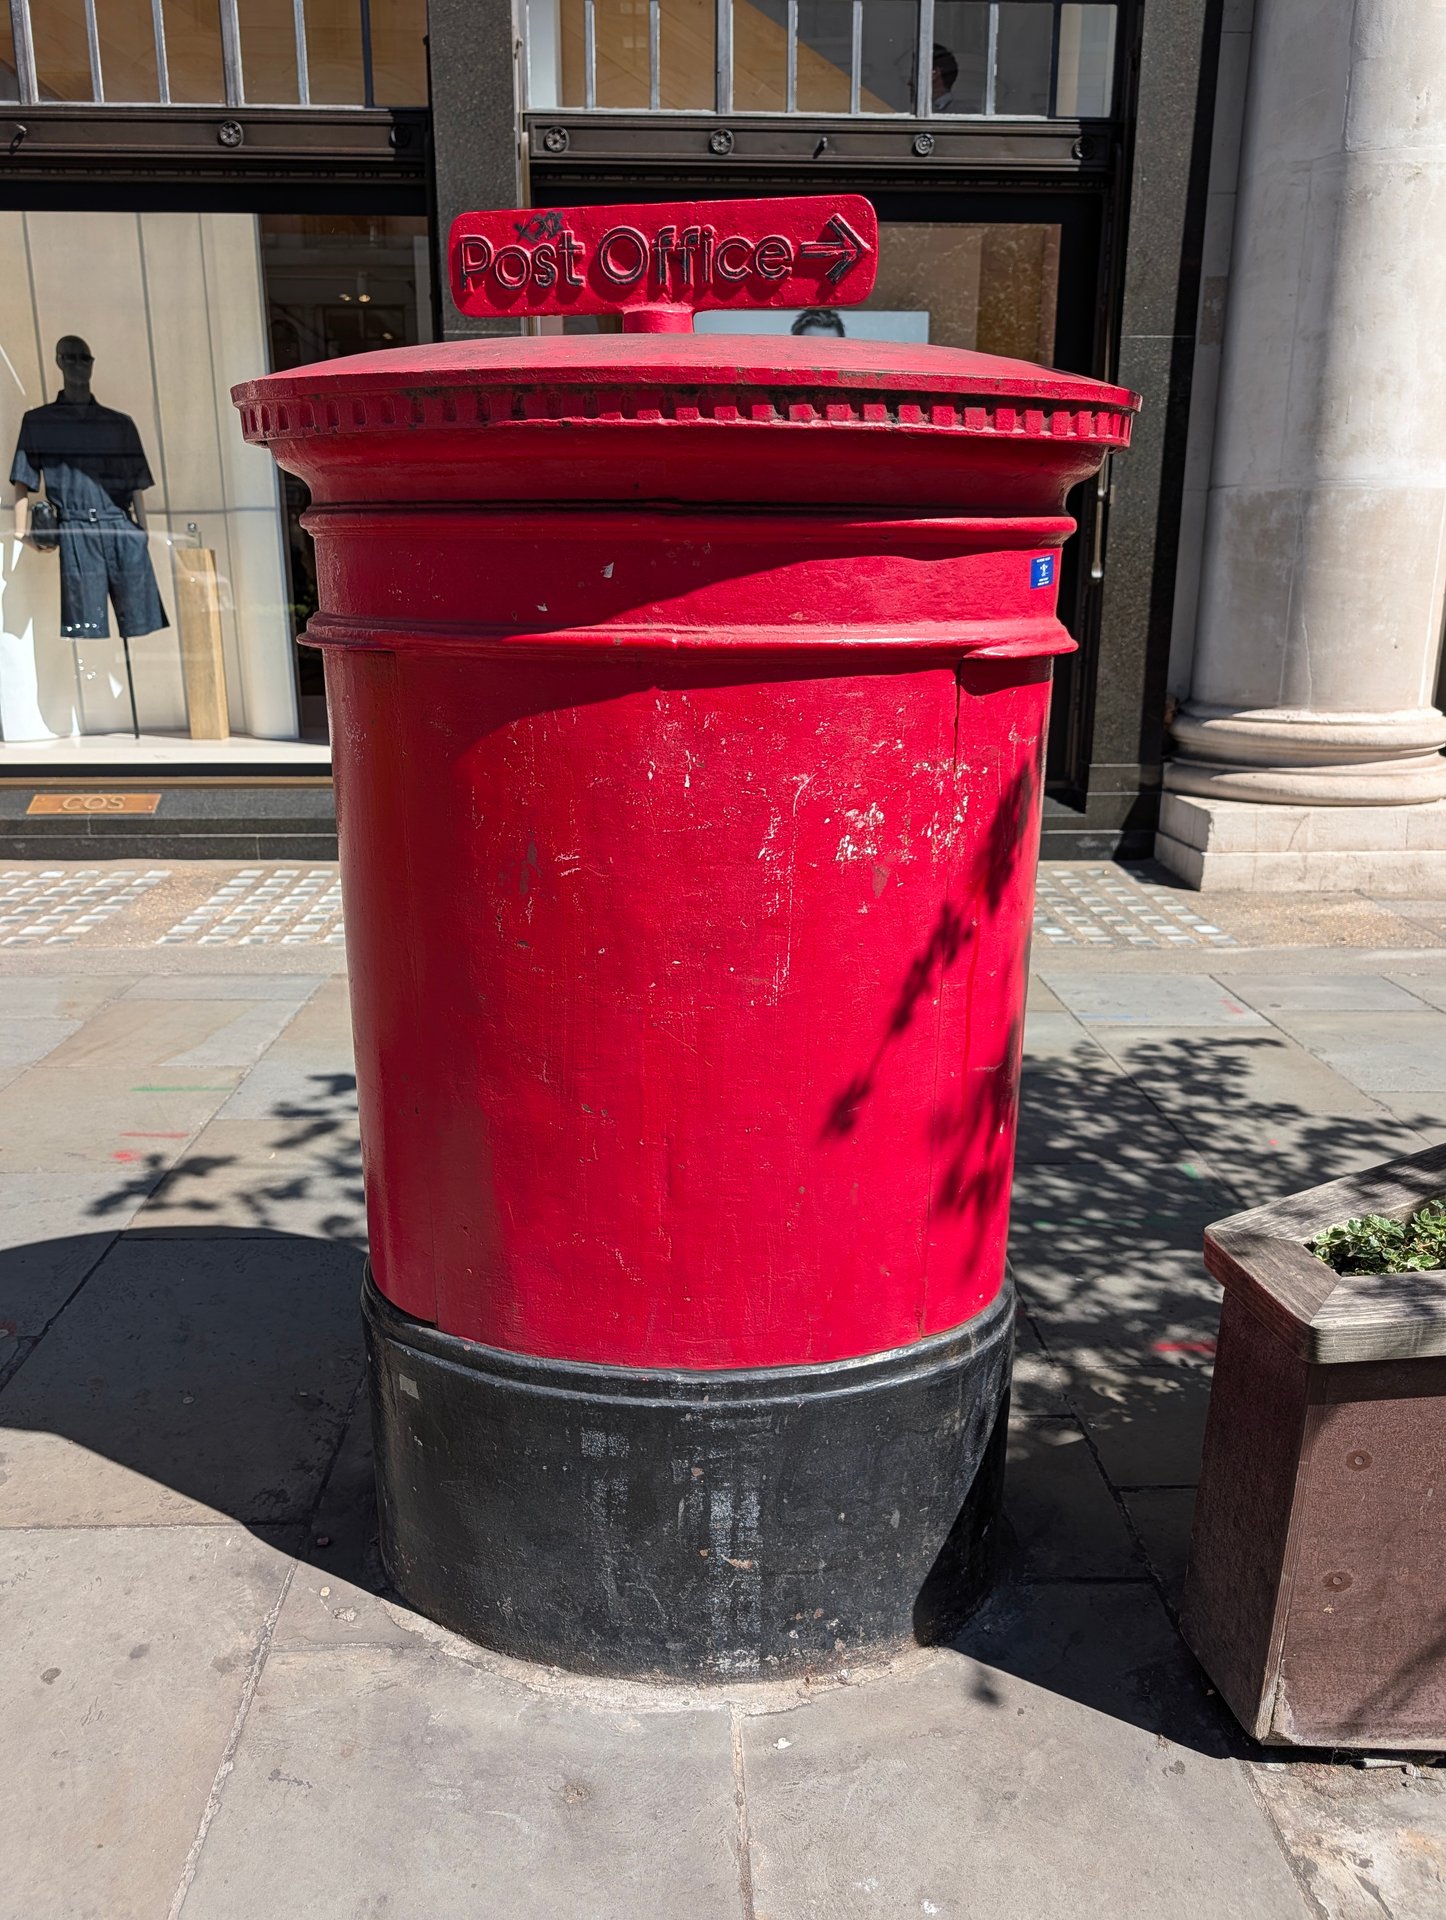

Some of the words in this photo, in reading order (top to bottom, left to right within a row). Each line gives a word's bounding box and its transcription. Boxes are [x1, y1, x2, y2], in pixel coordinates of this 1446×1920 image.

[459, 230, 586, 291] Post
[599, 224, 795, 286] Office
[62, 795, 126, 811] COS
